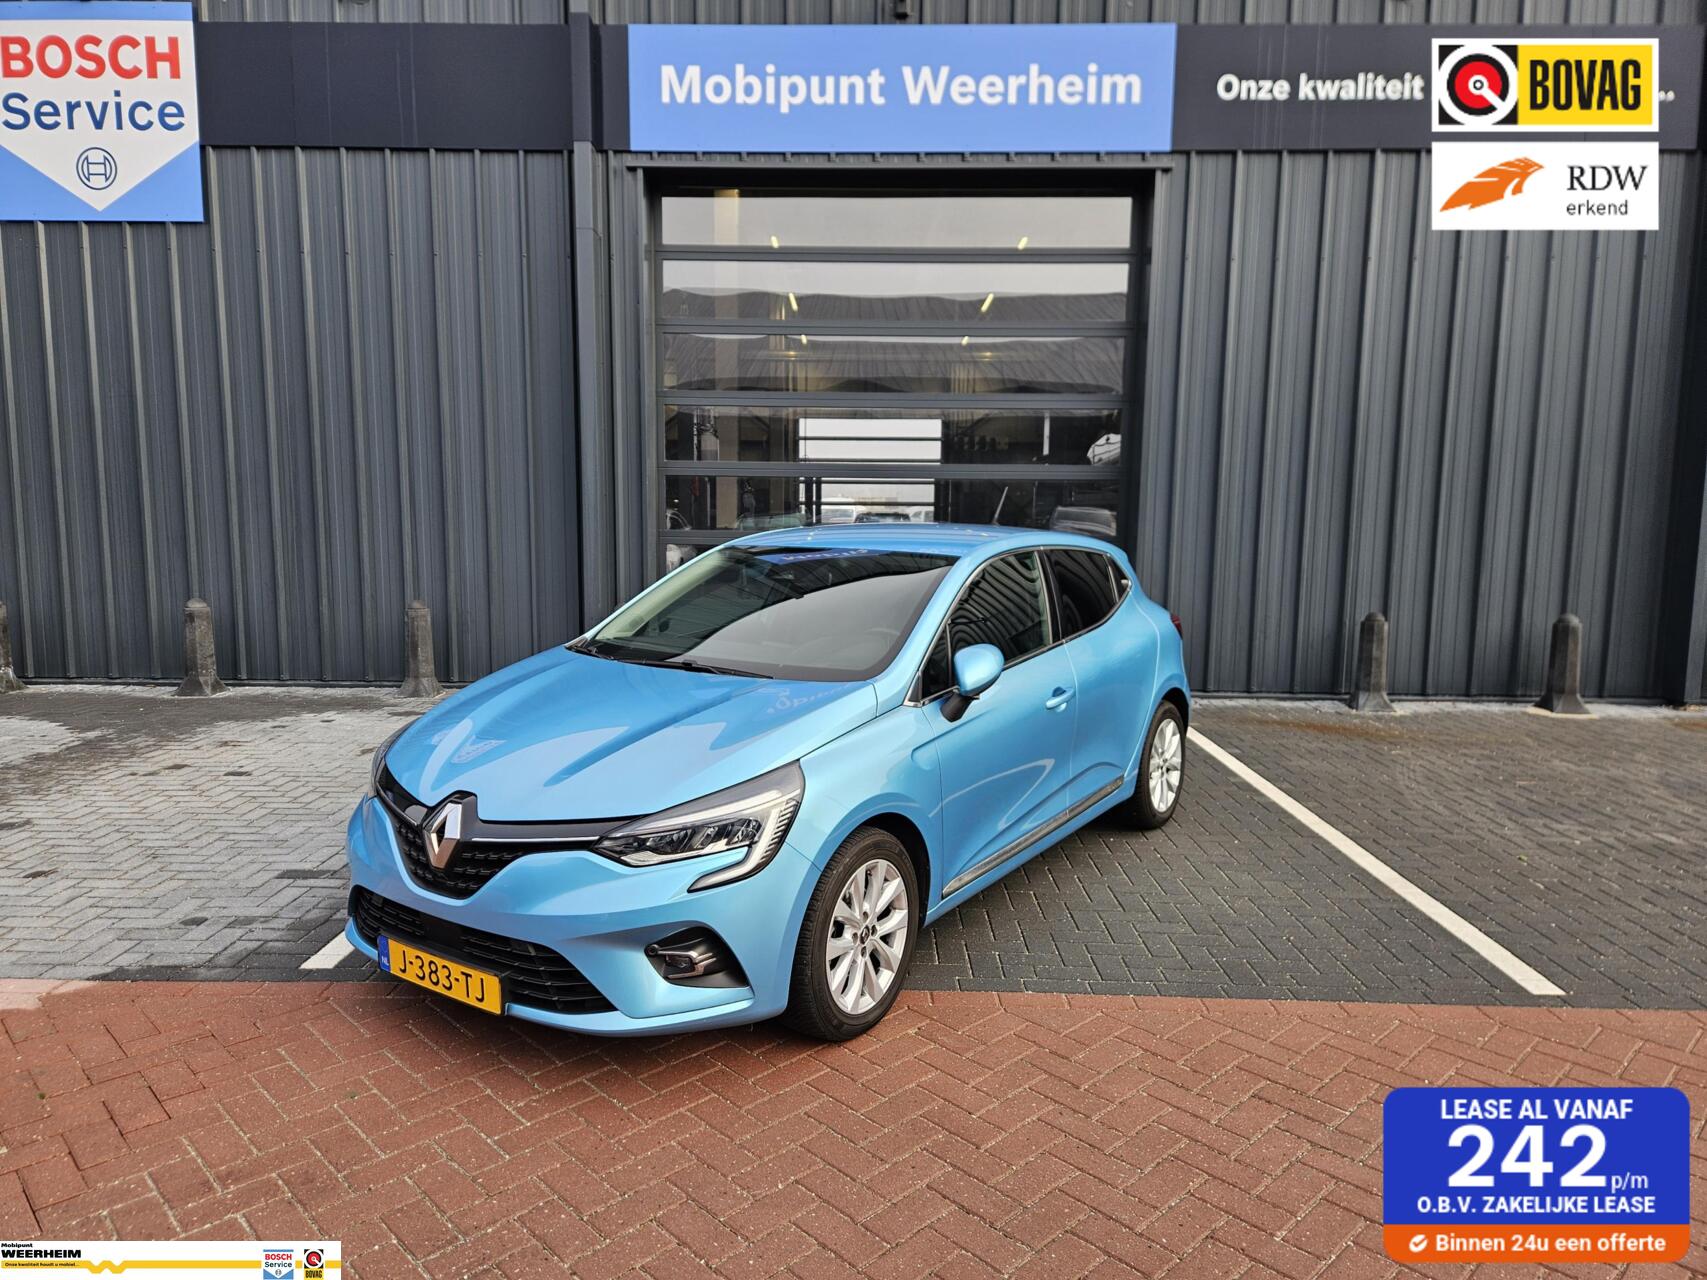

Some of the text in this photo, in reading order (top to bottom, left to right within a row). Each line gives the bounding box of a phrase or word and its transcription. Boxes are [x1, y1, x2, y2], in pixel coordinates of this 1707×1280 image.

[0, 34, 181, 80] BOSCH
[660, 63, 1142, 114] Mobipunt Weerheim
[1216, 72, 1425, 101] Onze kwaliteit
[1, 89, 186, 132] Service
[399, 949, 486, 1003] J-383-TJ
